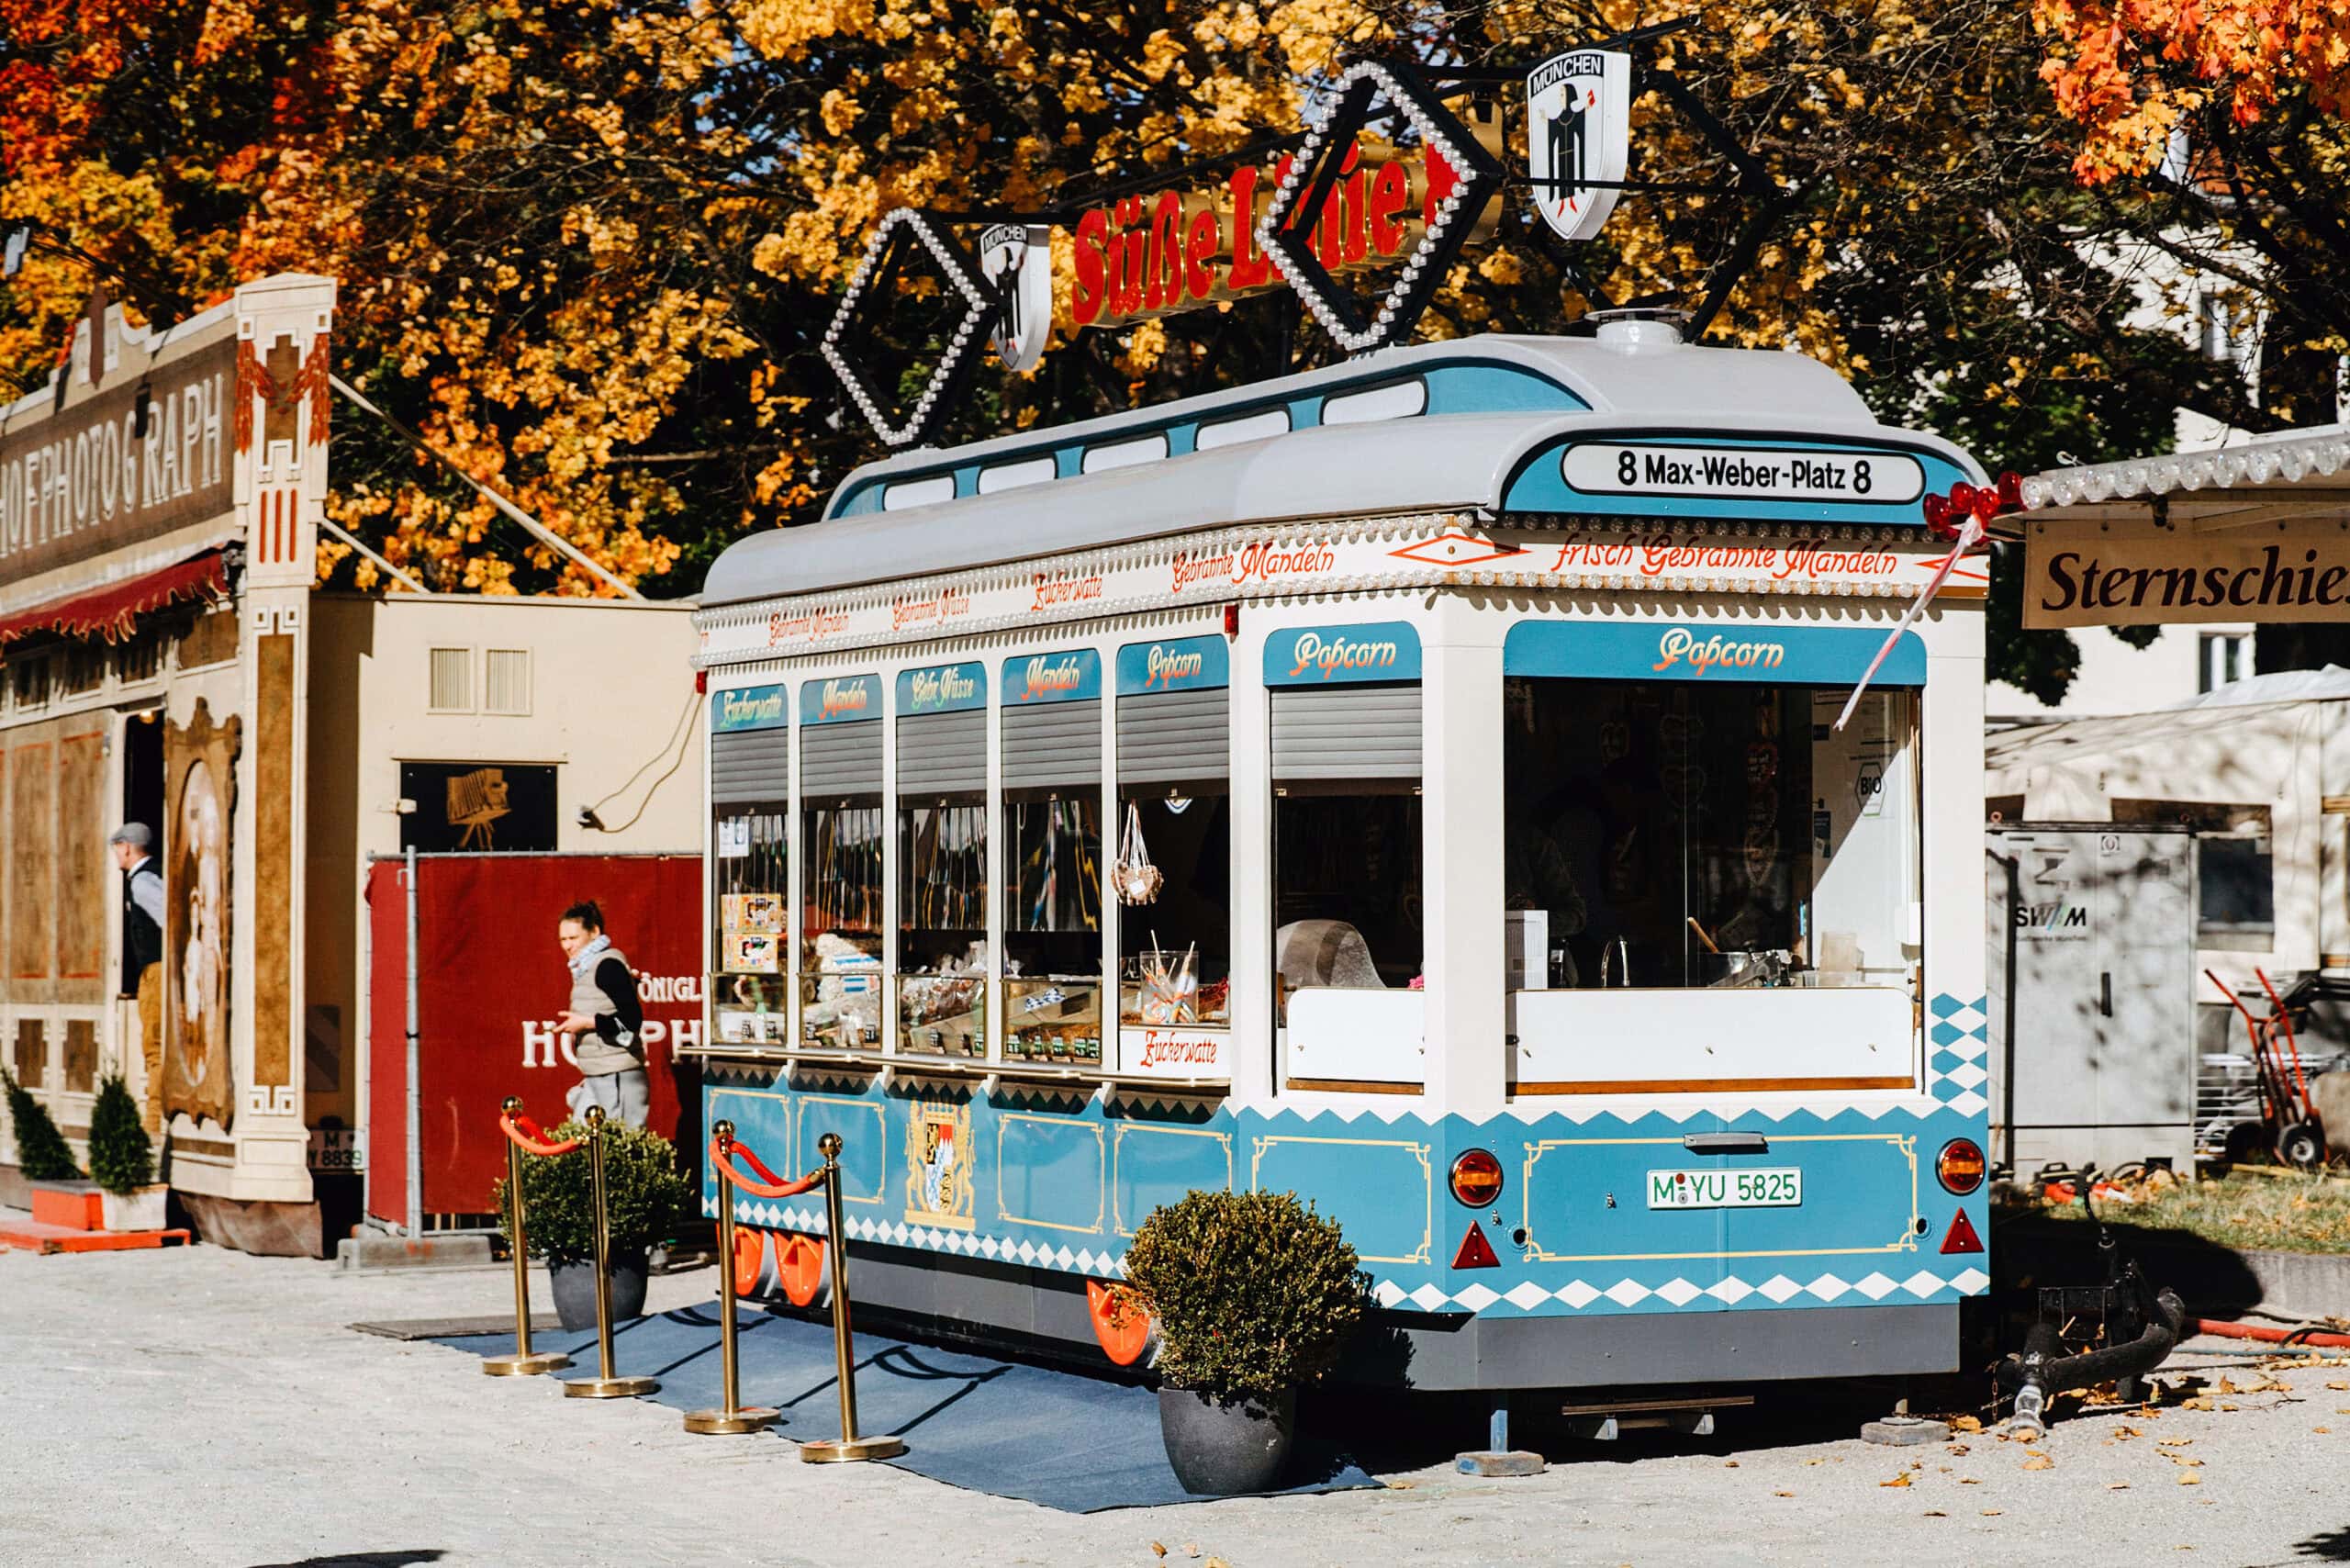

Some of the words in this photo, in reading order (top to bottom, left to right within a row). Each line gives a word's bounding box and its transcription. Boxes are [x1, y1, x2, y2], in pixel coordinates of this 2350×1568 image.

[1533, 55, 1602, 94] MÜNCHEN
[1072, 189, 1218, 325] Süße
[1617, 450, 1638, 486] 8
[1645, 454, 1846, 490] Max-Weber-Platz
[1852, 460, 1873, 494] 8
[1172, 550, 1234, 594] Gebrannte
[1231, 540, 1335, 585] Mandeln
[1550, 532, 1635, 573] frisch
[1639, 533, 1776, 577] Gebrannte
[1772, 538, 1897, 580] Mandeln
[2041, 545, 2350, 611] Sternschie
[1030, 569, 1102, 612] Zuckerwatte
[1145, 644, 1203, 689] Popcorn
[1289, 631, 1397, 680] Popcorn
[1653, 627, 1785, 677] Popcorn
[818, 679, 867, 721] Mandeln
[1020, 655, 1080, 701] Mandeln
[1140, 1029, 1218, 1068] Zuckerwatte
[1737, 1173, 1797, 1202] 5825
